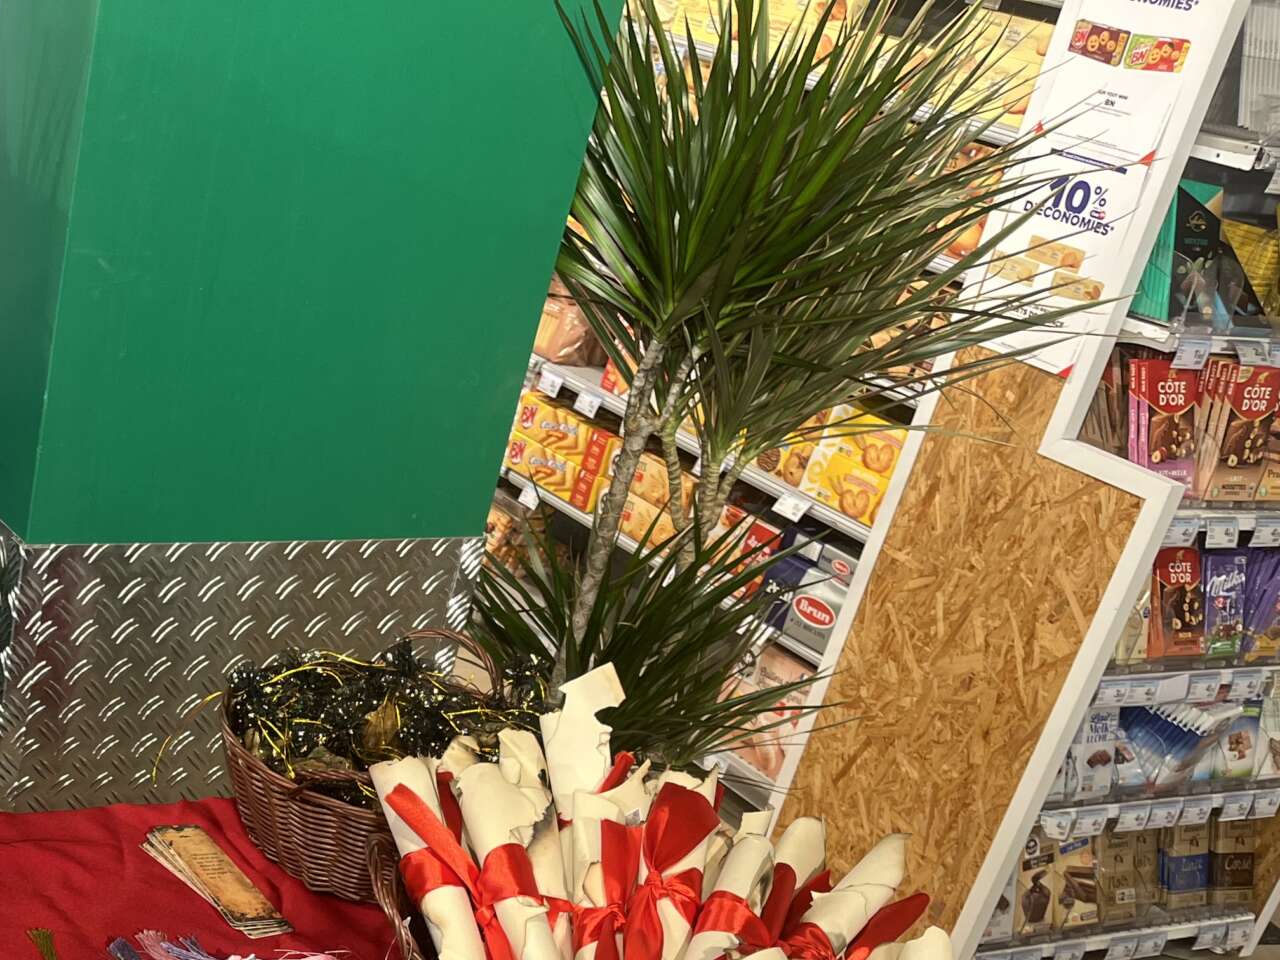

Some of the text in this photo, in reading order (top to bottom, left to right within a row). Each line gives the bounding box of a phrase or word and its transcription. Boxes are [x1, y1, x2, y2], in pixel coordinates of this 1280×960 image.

[1157, 379, 1187, 394] CÔTE
[1243, 384, 1272, 399] CÔTE
[1159, 394, 1185, 406] D'OR
[1241, 399, 1268, 412] D'OR
[1168, 560, 1192, 573] CÔTE
[1170, 573, 1192, 584] D'OR
[1206, 569, 1246, 597] Milka
[800, 599, 830, 624] Brun
